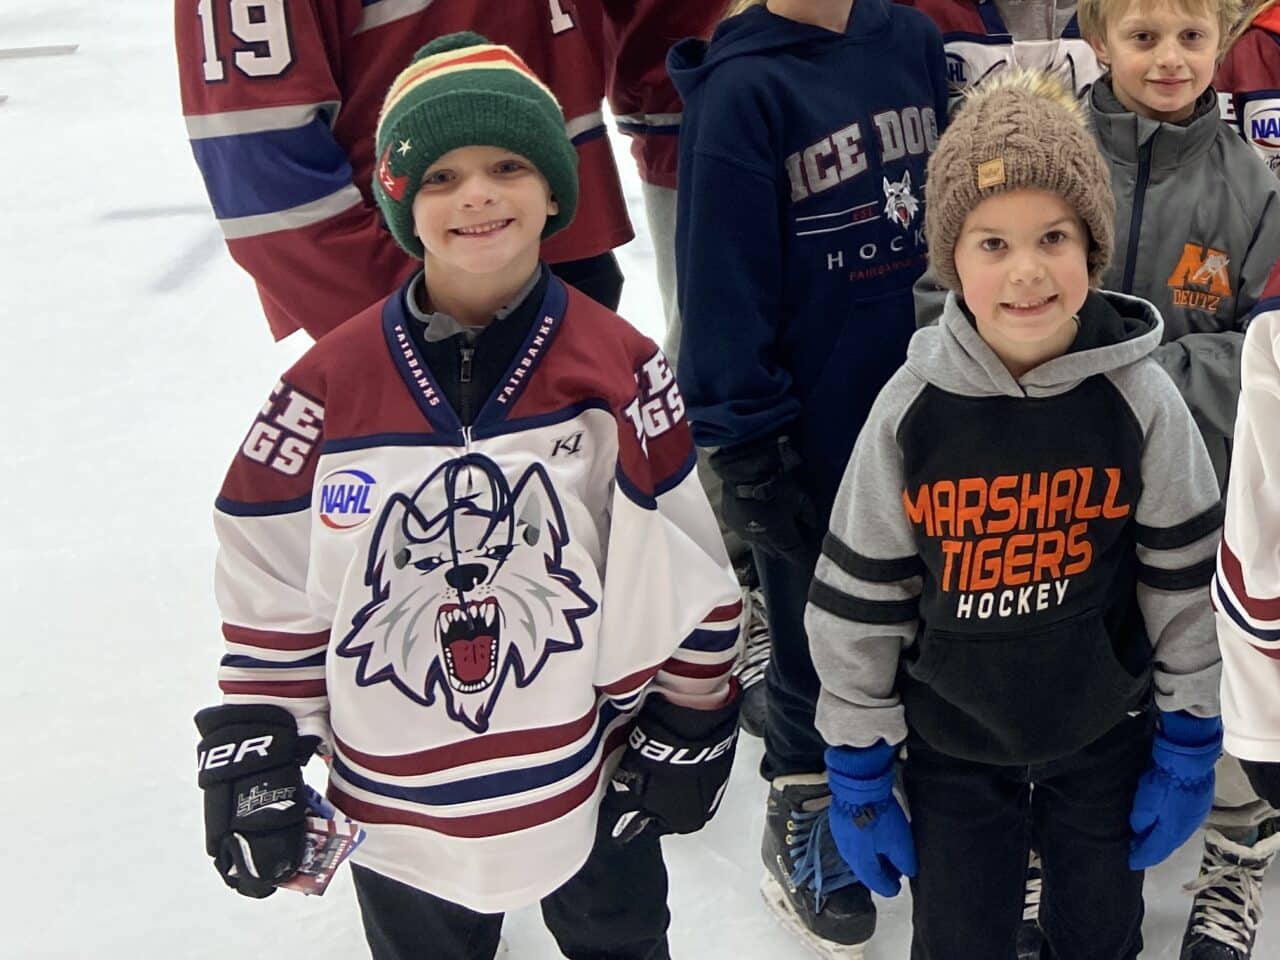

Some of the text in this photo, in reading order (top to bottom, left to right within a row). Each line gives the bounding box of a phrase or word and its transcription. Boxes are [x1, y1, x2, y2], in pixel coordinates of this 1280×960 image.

[784, 123, 868, 202] ICE
[1173, 288, 1221, 314] DEUTZ
[496, 314, 555, 405] FAIRBANKS
[319, 483, 371, 515] NAHL
[902, 466, 1130, 538] MARSHALL
[942, 521, 1093, 593] TIGERS
[956, 579, 1070, 620] HOCKEY
